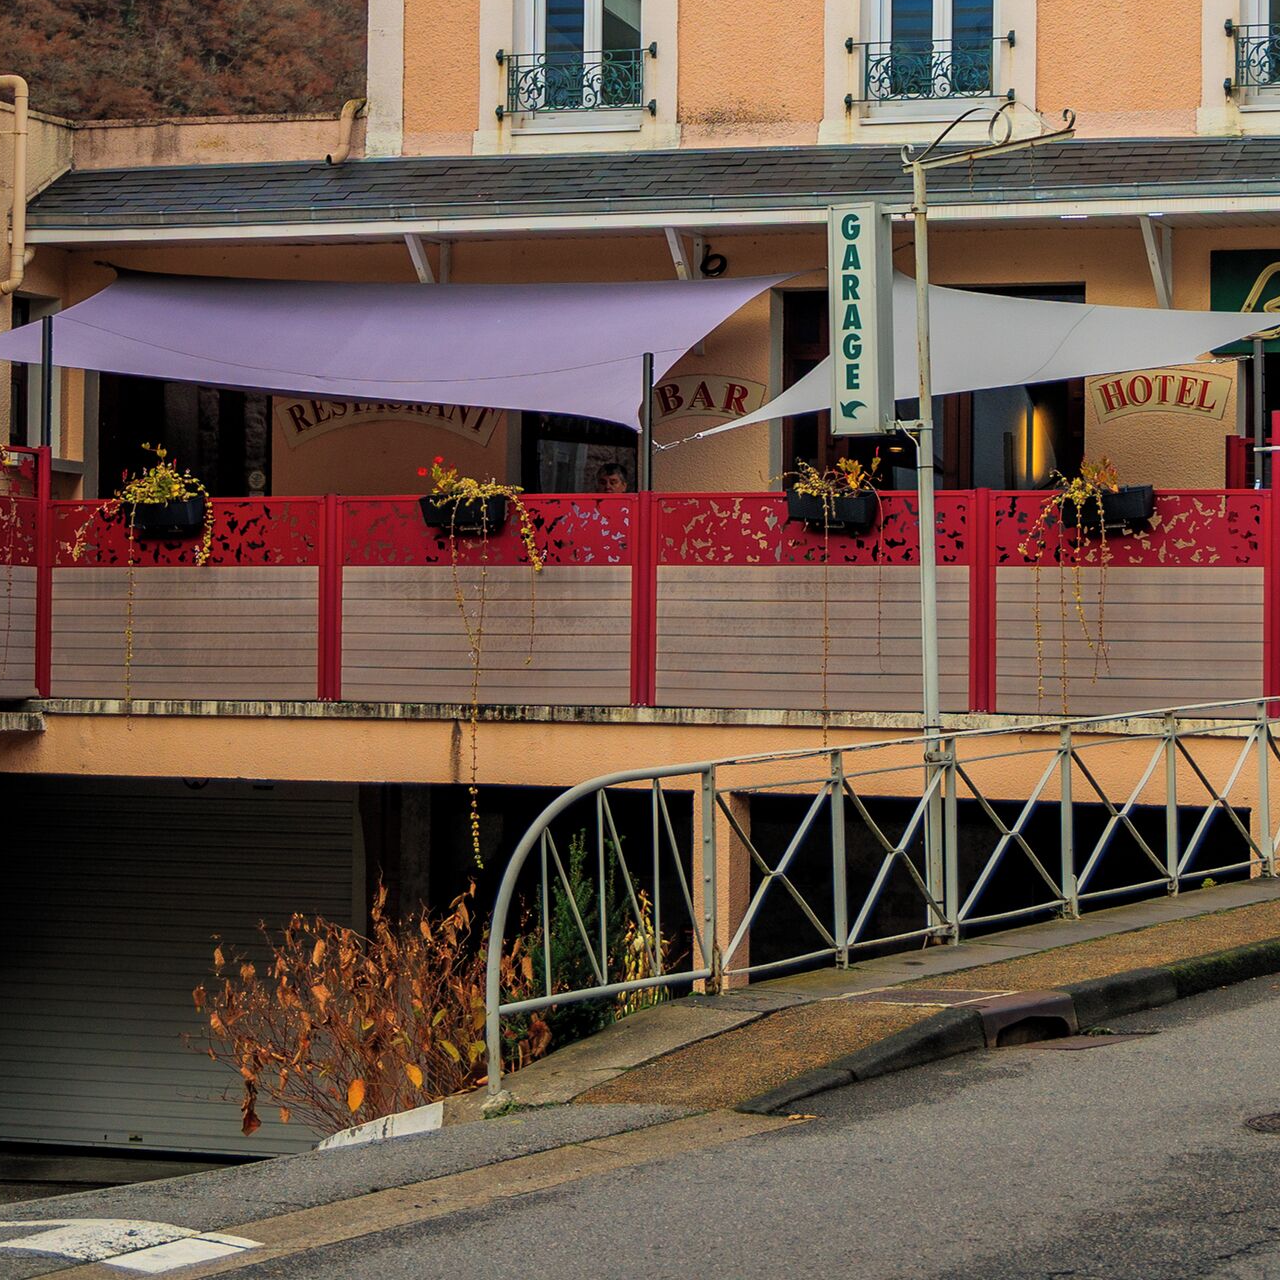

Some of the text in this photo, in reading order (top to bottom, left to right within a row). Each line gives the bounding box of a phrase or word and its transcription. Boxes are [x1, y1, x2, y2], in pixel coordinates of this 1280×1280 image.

[841, 213, 862, 390] GARAGE
[654, 381, 749, 417] BAR
[1098, 374, 1218, 414] HOTEL
